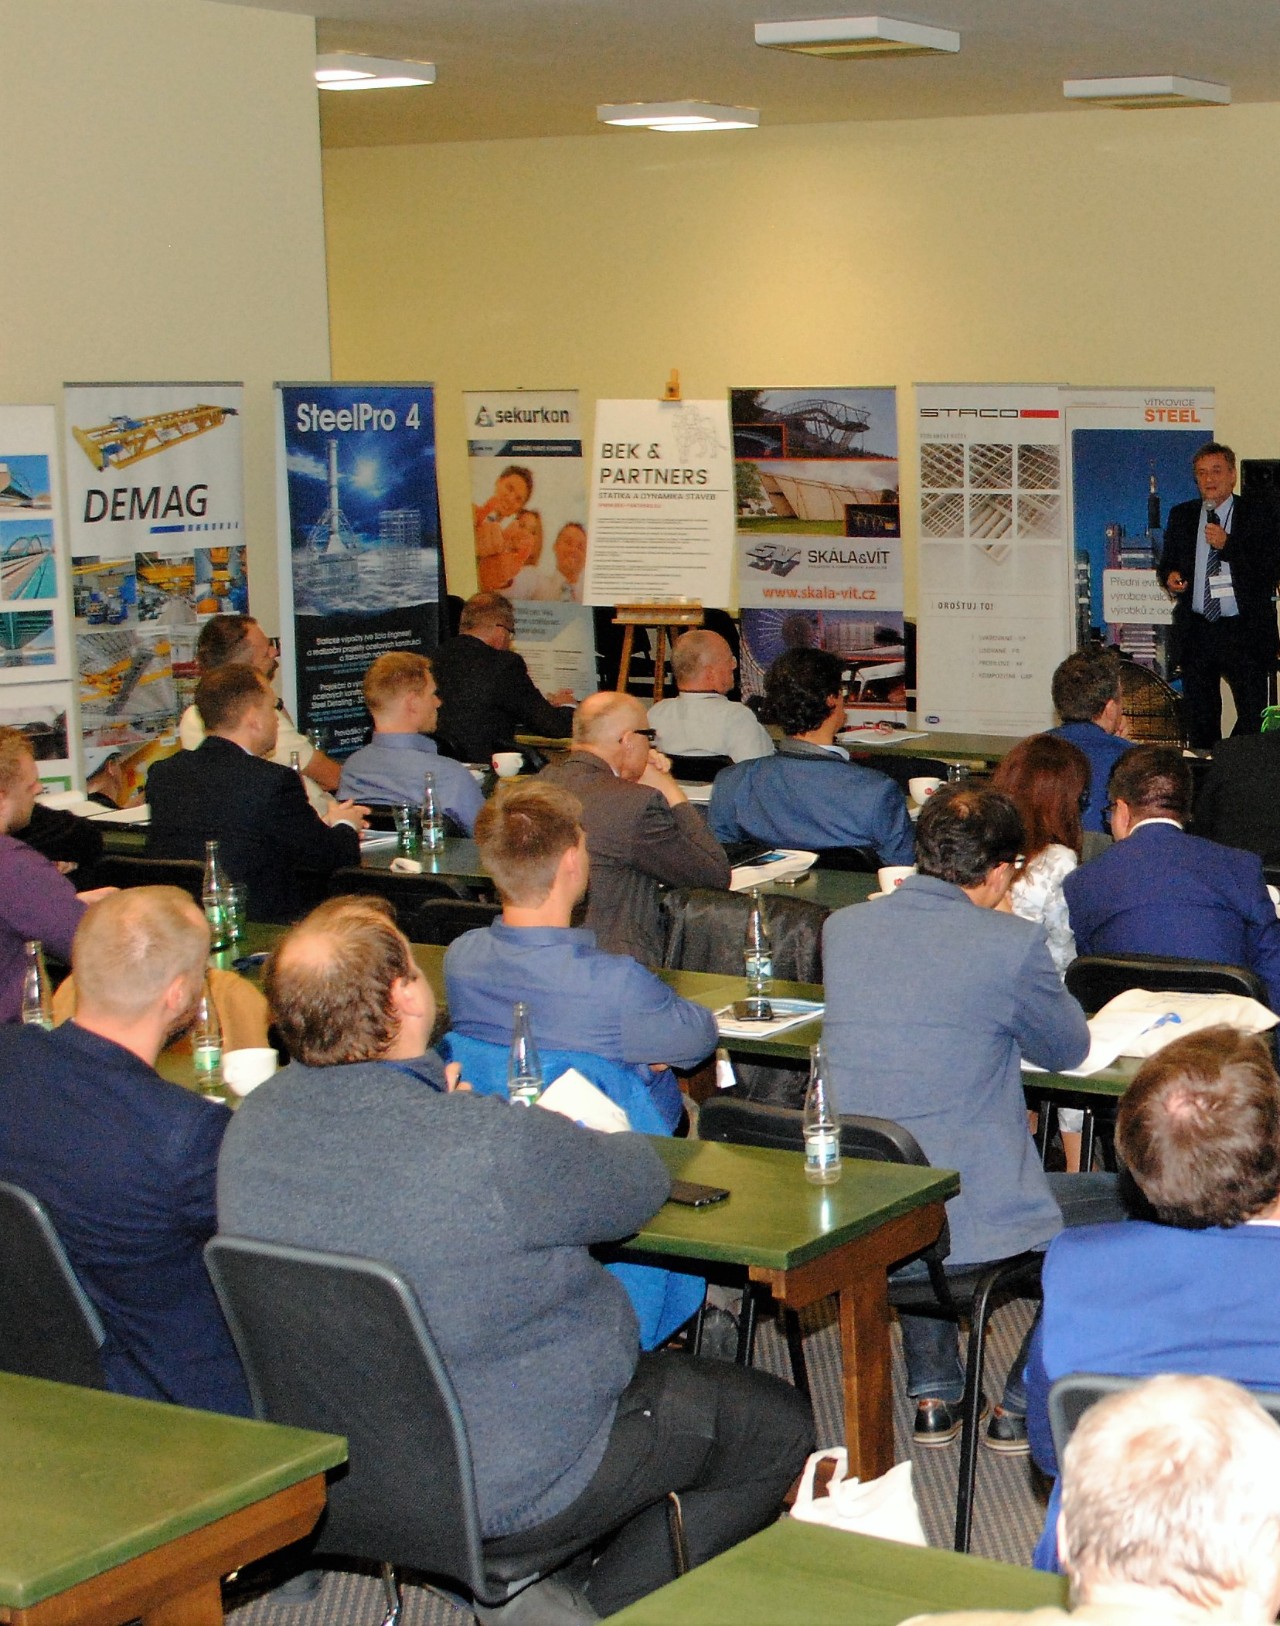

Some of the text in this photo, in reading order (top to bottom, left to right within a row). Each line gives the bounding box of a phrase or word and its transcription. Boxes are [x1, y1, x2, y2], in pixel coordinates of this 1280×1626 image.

[297, 402, 420, 432] SteelPro 4
[495, 406, 570, 423] sekurkon
[920, 408, 1018, 417] STACO
[1144, 408, 1201, 423] STEEL
[601, 443, 660, 459] BEK &
[599, 468, 708, 485] PARTNERS
[83, 483, 209, 523] DEMAG
[1110, 577, 1139, 586] Přední
[1110, 591, 1146, 602] výrobce
[1110, 605, 1146, 615] výrobků
